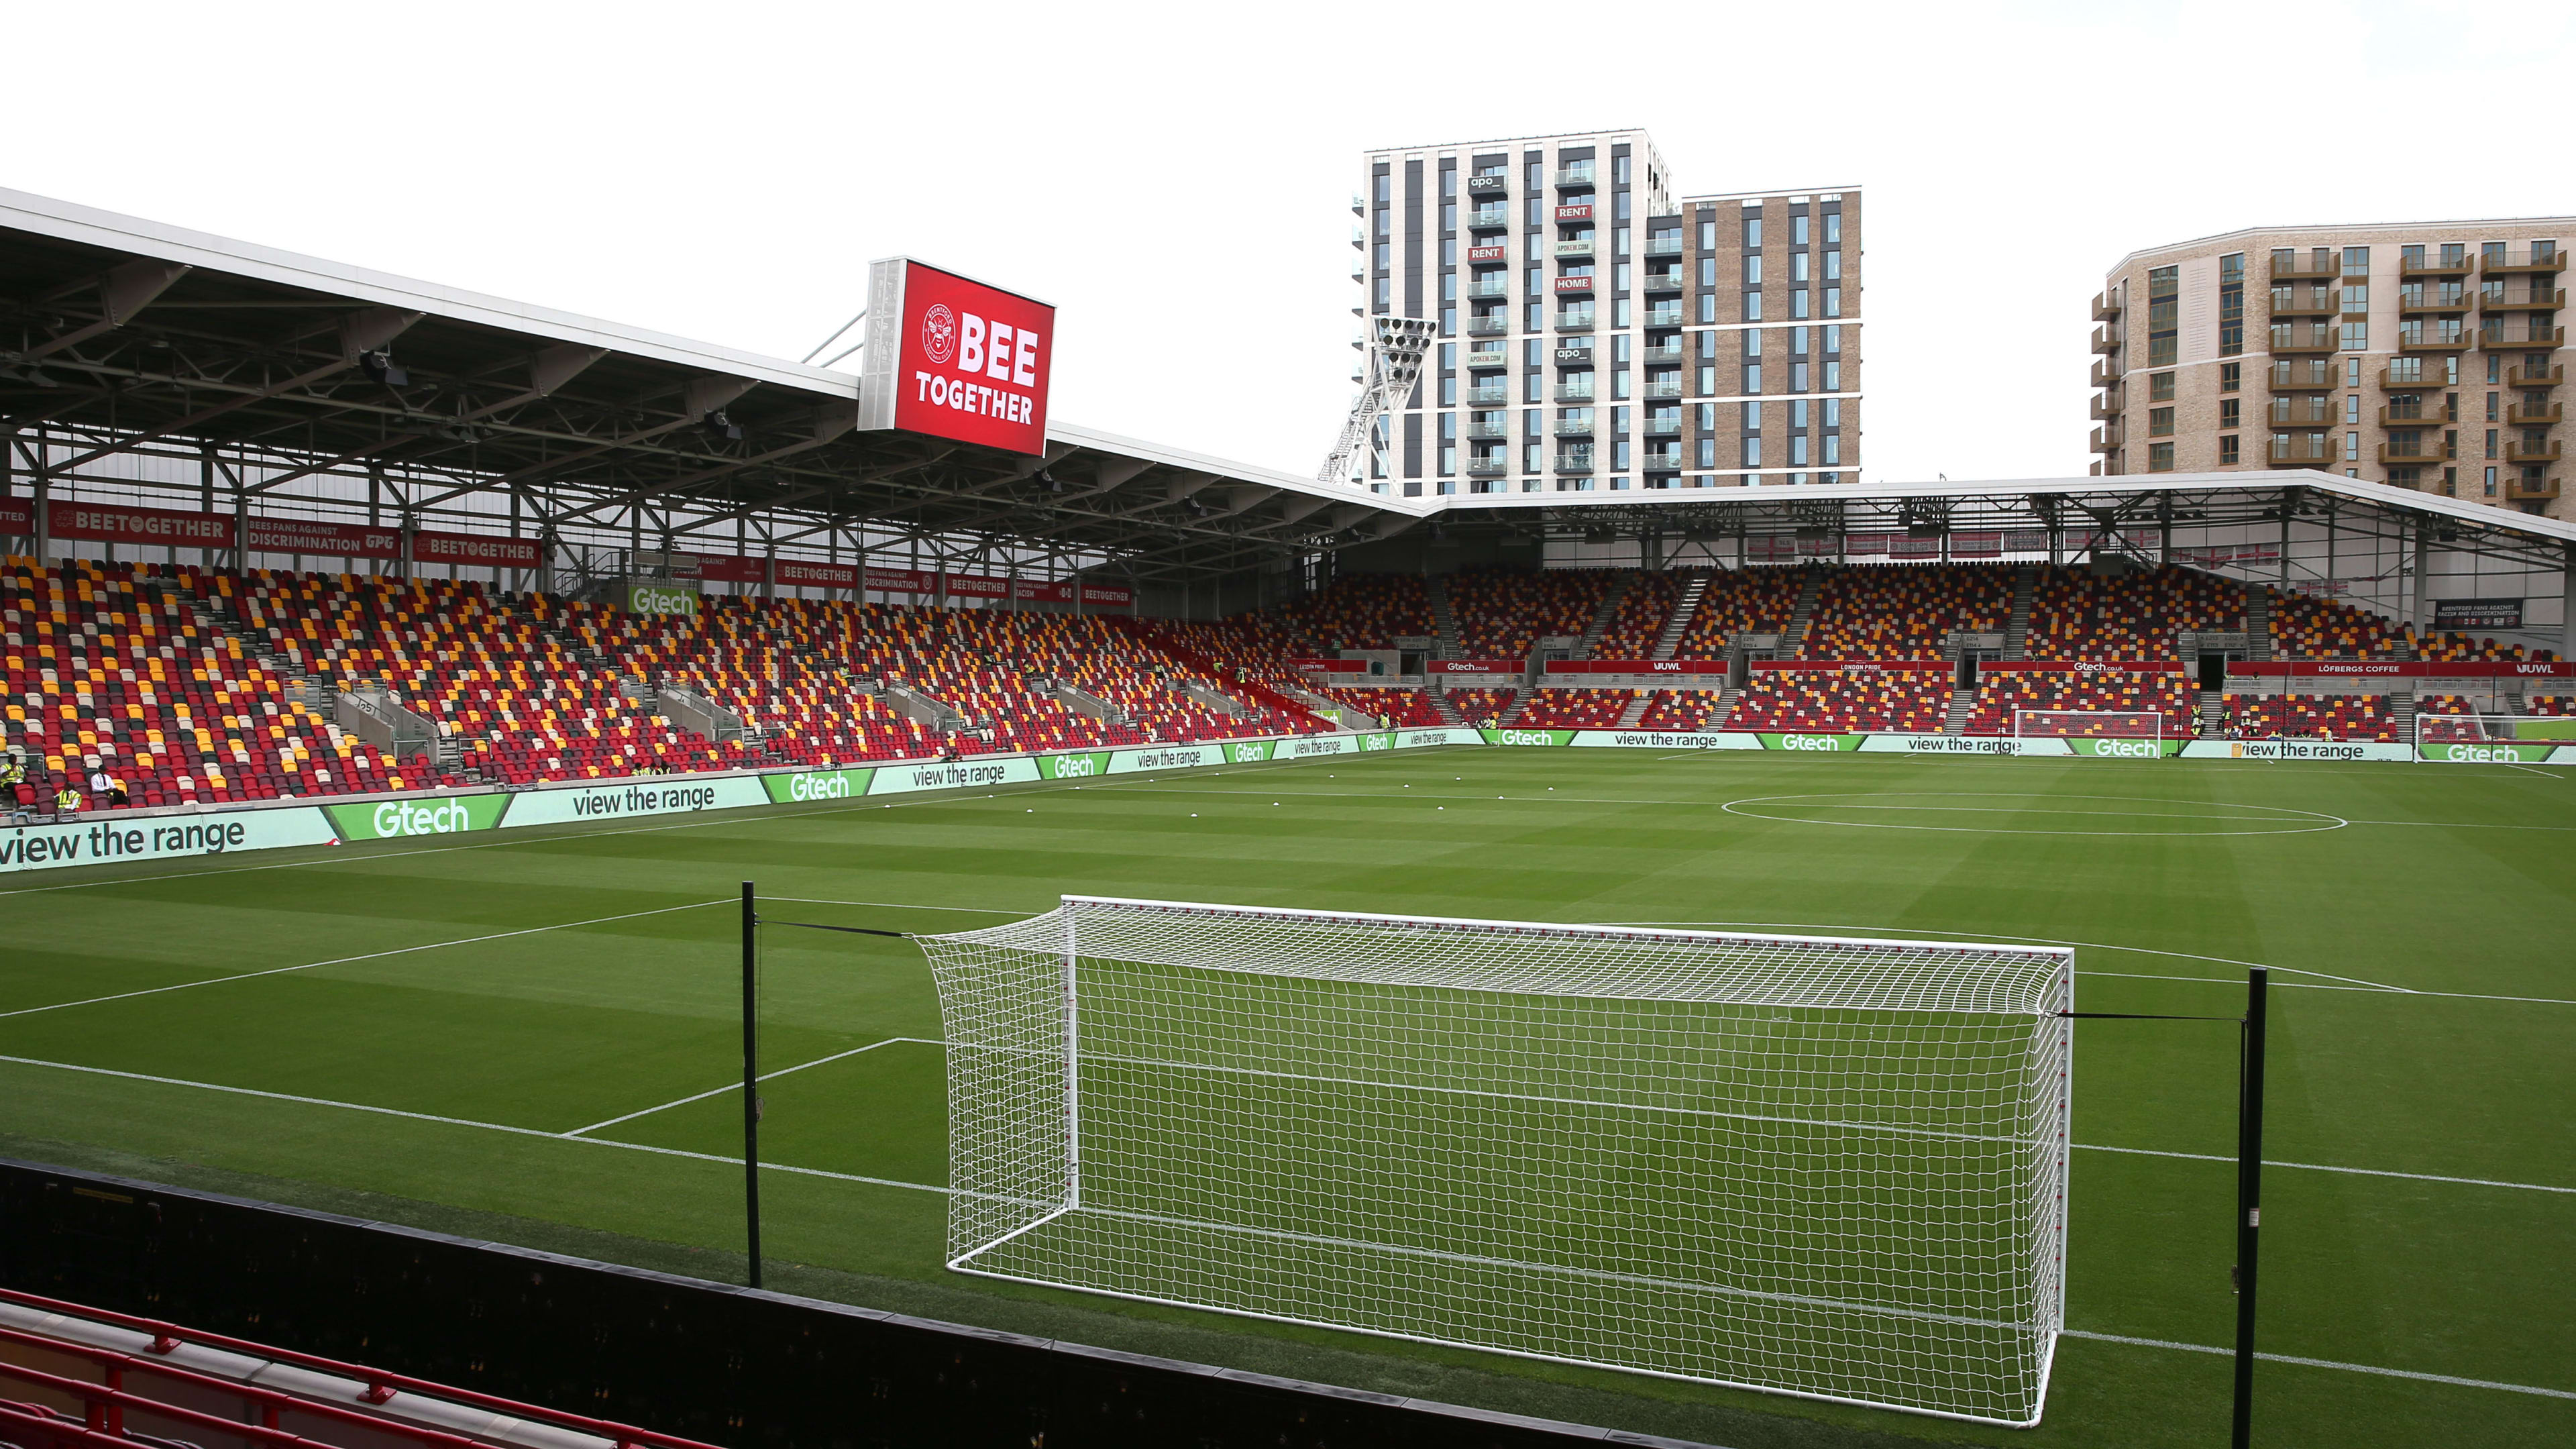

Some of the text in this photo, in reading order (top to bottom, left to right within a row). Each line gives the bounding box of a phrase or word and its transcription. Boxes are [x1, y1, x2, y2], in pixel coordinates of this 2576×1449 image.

[1558, 207, 1587, 217] RENT
[1472, 248, 1499, 258] RENT
[1557, 244, 1589, 252] APOKEW.COM
[1557, 279, 1589, 288] HOME
[928, 307, 952, 324] BRENTFORD
[957, 311, 1038, 388] BEE
[1470, 355, 1501, 363] APOKEW.COM
[916, 370, 1032, 425] TOGETHER
[250, 521, 337, 535] BEES FANS AGAINST
[250, 533, 360, 551] DISCRIMINATION
[366, 534, 394, 549] GPG
[702, 557, 727, 566] AGAINST
[865, 577, 918, 589] DISCRIMINATION
[634, 588, 693, 614] Gtech
[1447, 662, 1489, 671] Gtech.co.uk
[2074, 662, 2124, 672] Gtech.co.uk
[2318, 664, 2363, 672] LÖFBERGS
[1366, 733, 1388, 751] Gtech
[1410, 733, 1446, 745] view the range
[1501, 729, 1552, 746] Gtech
[1615, 733, 1717, 749] view the range
[1782, 734, 1838, 751] Gtech
[1909, 737, 2022, 755] view the range
[1235, 742, 1263, 762] Gtech
[1295, 740, 1341, 754] view the range
[2094, 739, 2157, 757] Gtech
[2281, 742, 2308, 757] the
[2313, 745, 2364, 759] range
[2447, 744, 2519, 761] Gtech
[1055, 755, 1093, 778] Gtech
[1138, 749, 1201, 767] view the range
[912, 764, 1005, 786] view the range
[790, 773, 849, 801] Gtech
[574, 786, 714, 816] view the range
[373, 800, 470, 838] Gtech
[0, 820, 245, 865] view the range
